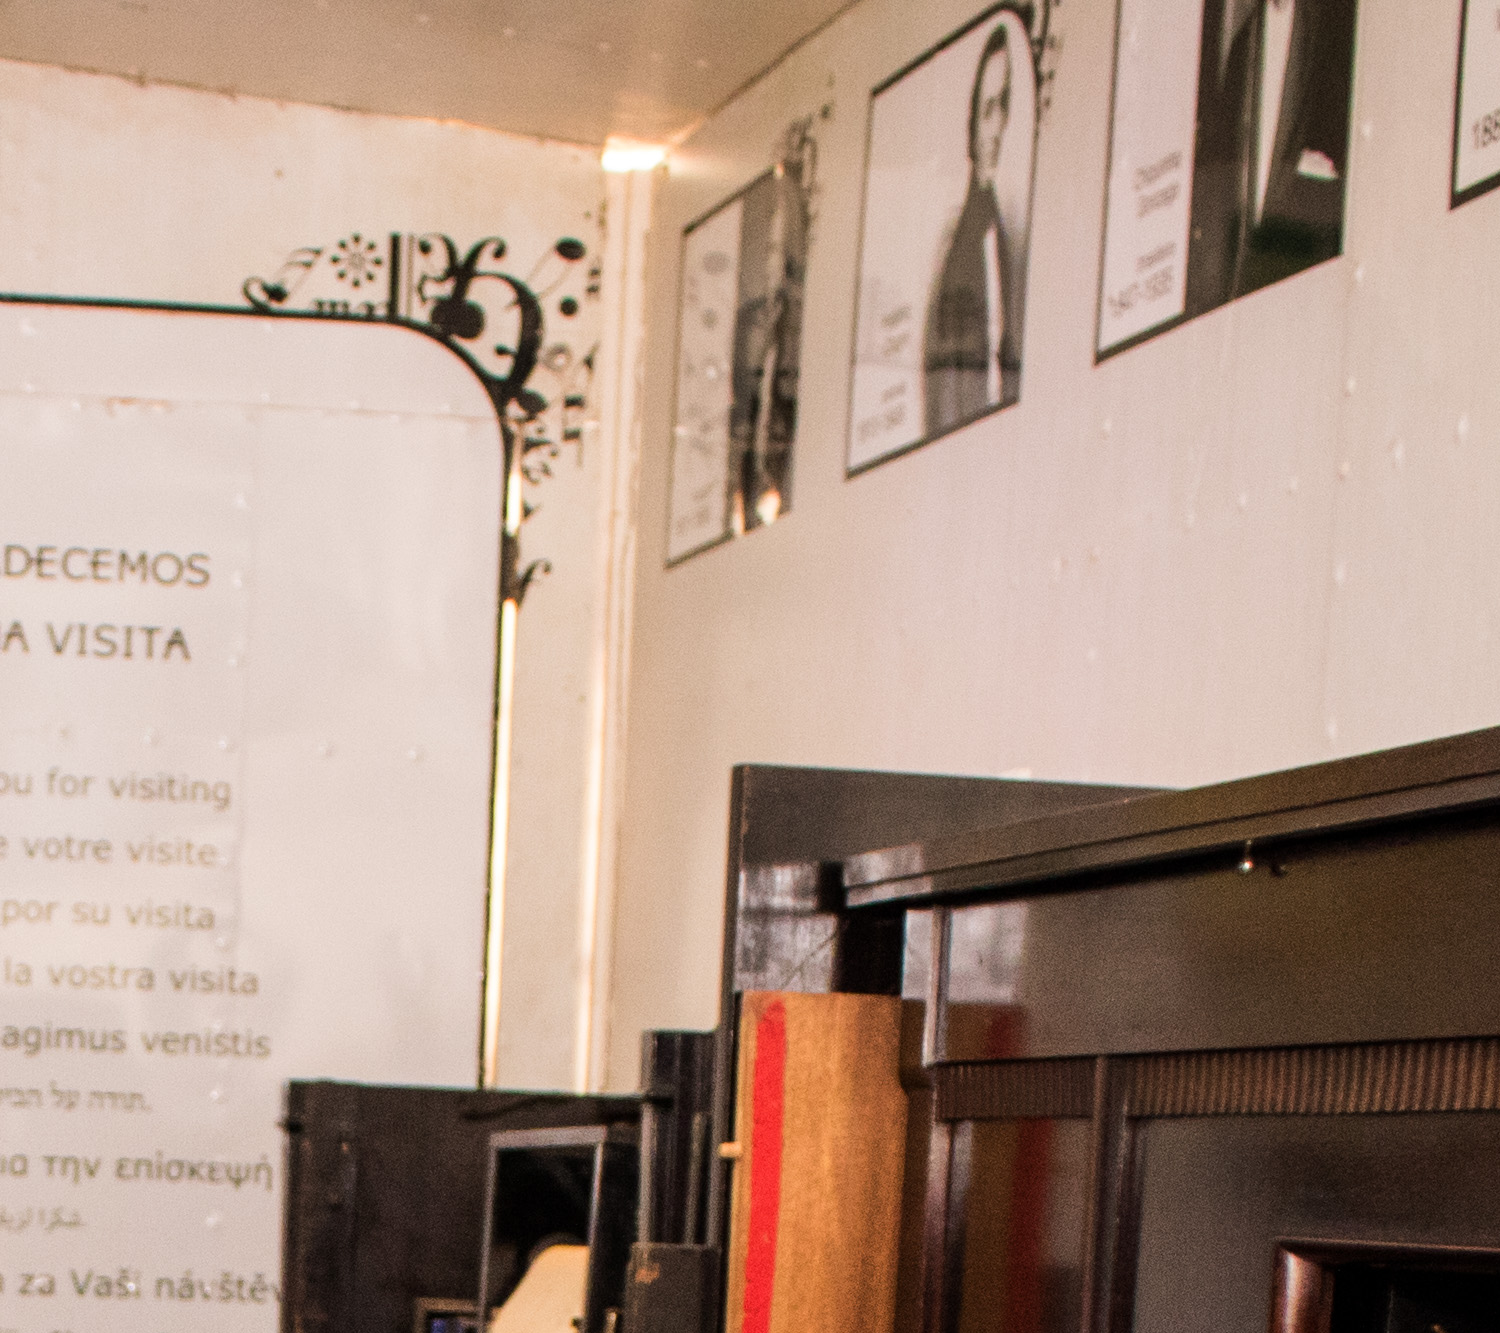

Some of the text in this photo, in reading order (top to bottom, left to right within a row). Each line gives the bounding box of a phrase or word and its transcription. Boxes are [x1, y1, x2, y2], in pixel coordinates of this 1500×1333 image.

[45, 621, 192, 662] VISITA
[46, 764, 95, 797] for
[107, 770, 233, 811] visiting
[20, 833, 113, 864] votre
[124, 833, 221, 867] visite
[0, 899, 60, 928] por
[70, 901, 112, 927] su
[124, 901, 217, 931] visita
[3, 955, 32, 986] la
[46, 960, 157, 991] vostra
[168, 964, 260, 996] visita
[0, 1022, 129, 1057] agimus
[140, 1026, 273, 1060] venistis
[41, 1154, 102, 1184] την
[17, 1269, 57, 1296] za
